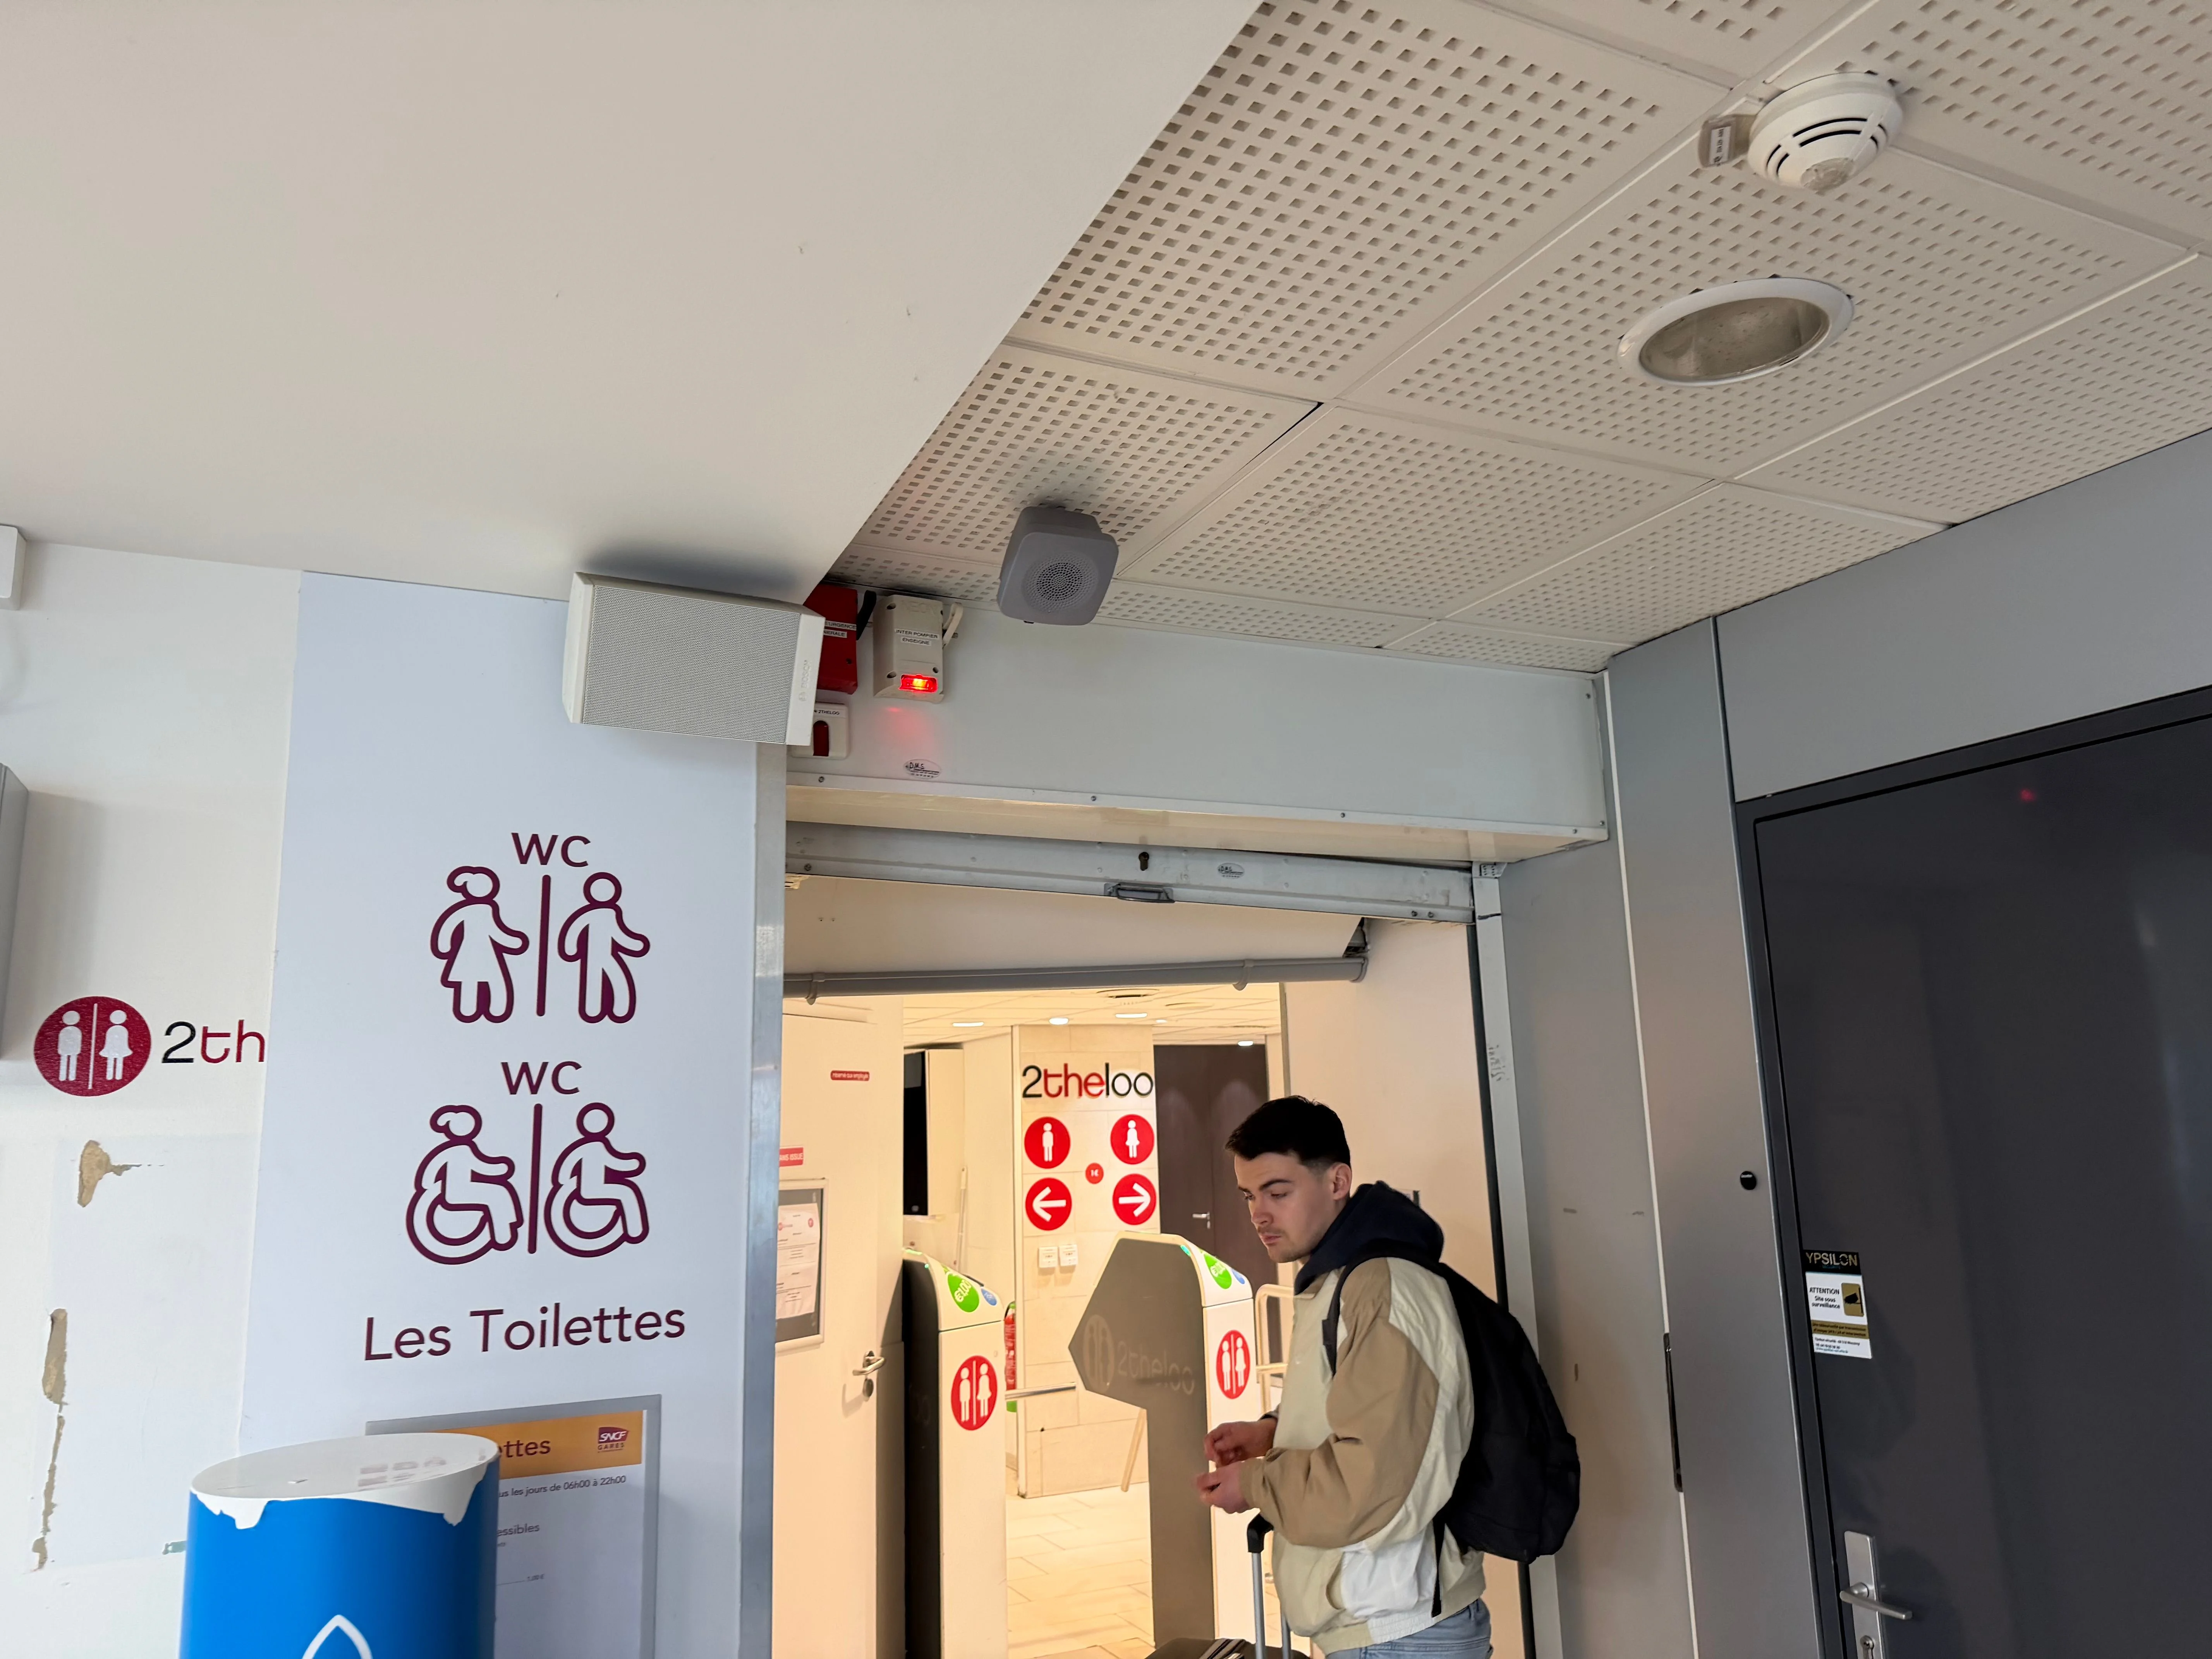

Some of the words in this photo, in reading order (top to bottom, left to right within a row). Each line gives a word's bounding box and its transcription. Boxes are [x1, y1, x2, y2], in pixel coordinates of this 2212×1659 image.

[511, 832, 591, 867] WC
[162, 1019, 266, 1064] 2th
[500, 1060, 582, 1095] WC
[1022, 1063, 1154, 1099] 2theloo
[1806, 1252, 1858, 1266] YPSILON
[1809, 1286, 1840, 1295] ATTENTION
[364, 1317, 451, 1361] Les
[470, 1302, 685, 1352] Toilettes
[599, 1431, 627, 1442] SNCF
[511, 1487, 524, 1496] les
[525, 1486, 547, 1497] jours
[550, 1483, 561, 1492] de
[563, 1479, 590, 1491] 06h00
[592, 1478, 598, 1486] à
[599, 1475, 627, 1486] 22h00
